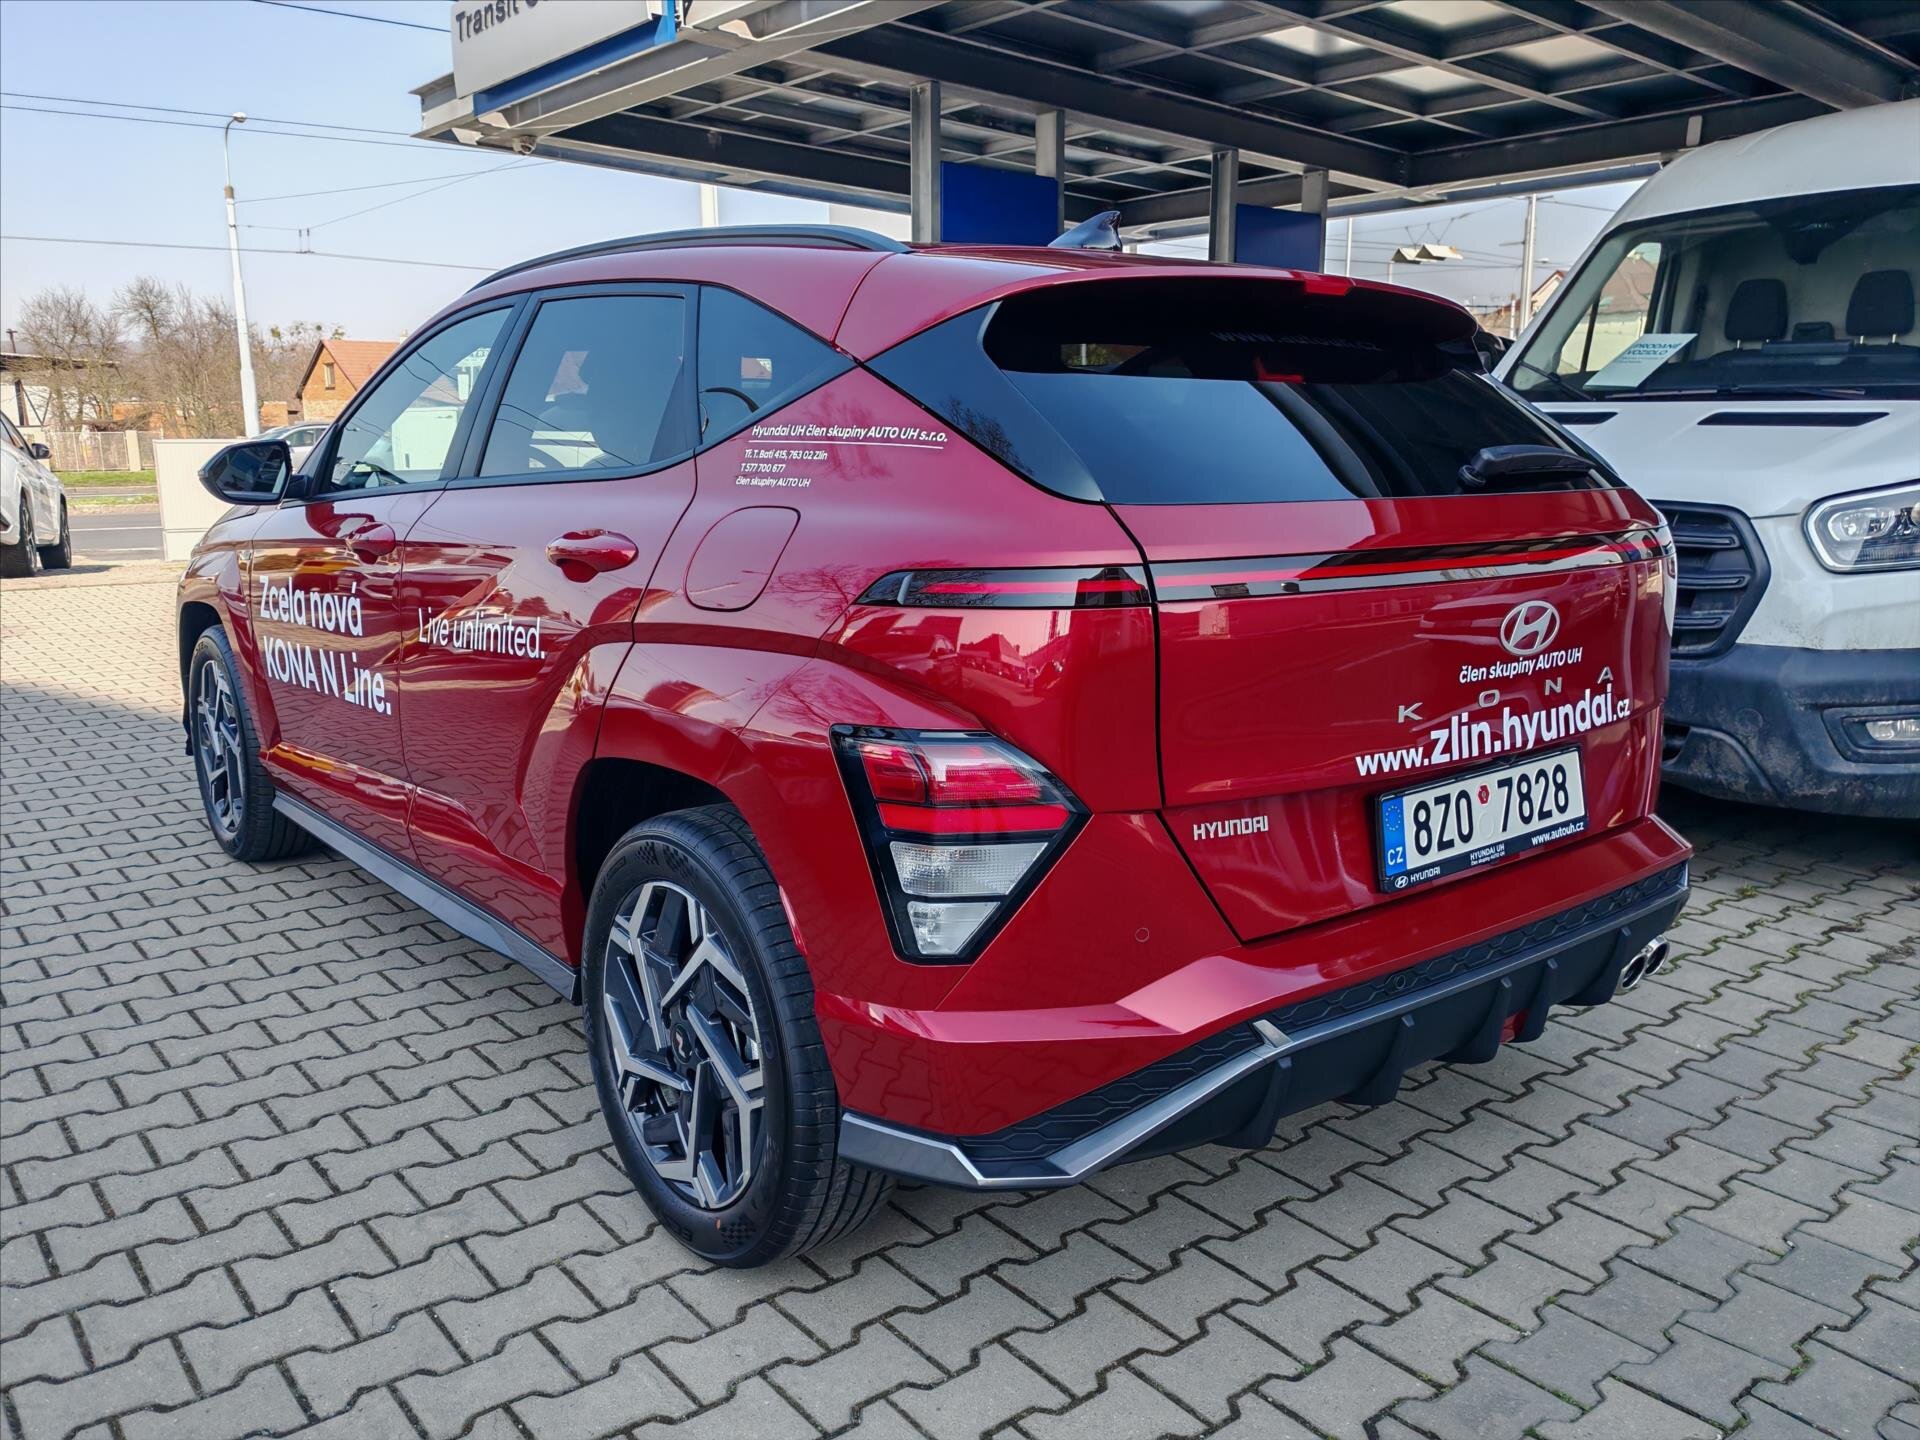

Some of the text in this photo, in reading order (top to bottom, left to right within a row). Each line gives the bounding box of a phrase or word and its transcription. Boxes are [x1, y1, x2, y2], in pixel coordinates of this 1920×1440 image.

[752, 424, 948, 442] Hyundai UH člen skupiny AUTO UH s.r.o.
[788, 450, 802, 460] 763
[803, 450, 813, 460] 02
[758, 463, 772, 473] 700
[735, 475, 811, 488] člen skupiny AUTO UH
[259, 575, 363, 637] Zcela nová
[418, 606, 545, 660] Live unlimited.
[263, 635, 320, 693] KONA
[319, 648, 340, 698] N
[340, 652, 392, 716] Line.
[1459, 647, 1583, 684] člen skupiny AUTO UH
[1398, 666, 1614, 723] KONA
[1355, 682, 1630, 776] www.zlin.hyundai.cz
[1497, 763, 1569, 833] 7828
[1193, 815, 1269, 840] HYUNDAI
[1531, 821, 1584, 846] www.autouh.cz
[1387, 846, 1404, 866] CZ
[1410, 866, 1441, 883] HYUNDAI
